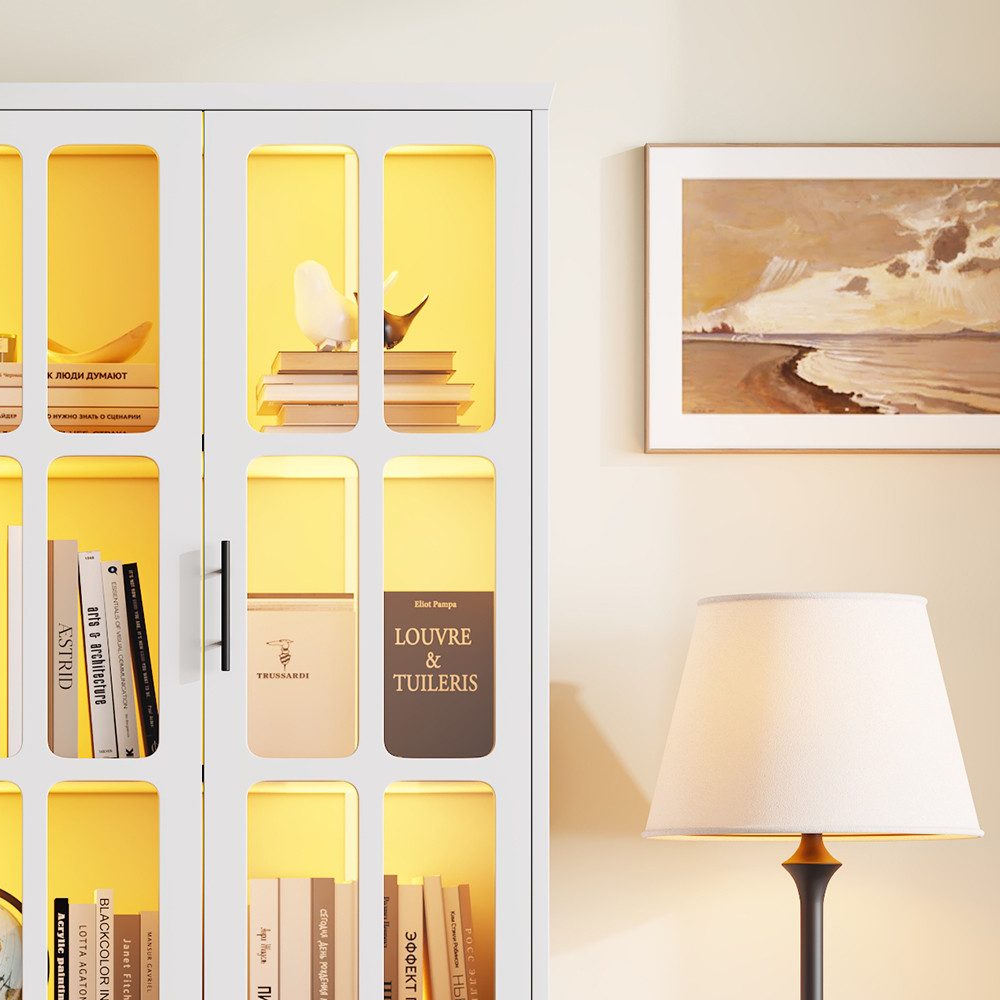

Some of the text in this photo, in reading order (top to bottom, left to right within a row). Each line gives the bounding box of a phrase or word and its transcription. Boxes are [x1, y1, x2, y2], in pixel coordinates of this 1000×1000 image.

[55, 372, 84, 380] ЛЮДИ
[86, 372, 127, 380] ДУМАЮТ
[87, 607, 101, 626] arts
[414, 600, 457, 609] Eliot Pampa
[395, 628, 472, 645] LOUVRE
[58, 623, 73, 690] ÆSTRID
[426, 652, 441, 668] &
[90, 644, 107, 705] architecture
[393, 674, 478, 692] TUILERIS
[57, 912, 65, 954] Acrylic
[319, 909, 327, 938] СЕГОДНЯ
[79, 925, 87, 957] LOTTA
[100, 898, 109, 984] BLACKCOLOR
[317, 941, 328, 959] ДЕНЬ
[465, 928, 474, 962] РОСС
[123, 939, 131, 1000] Janet Fitch
[405, 932, 416, 992] ЭФФЕКТ
[319, 962, 328, 995] РОЖДЕНИЯ
[100, 990, 109, 1000] IN
